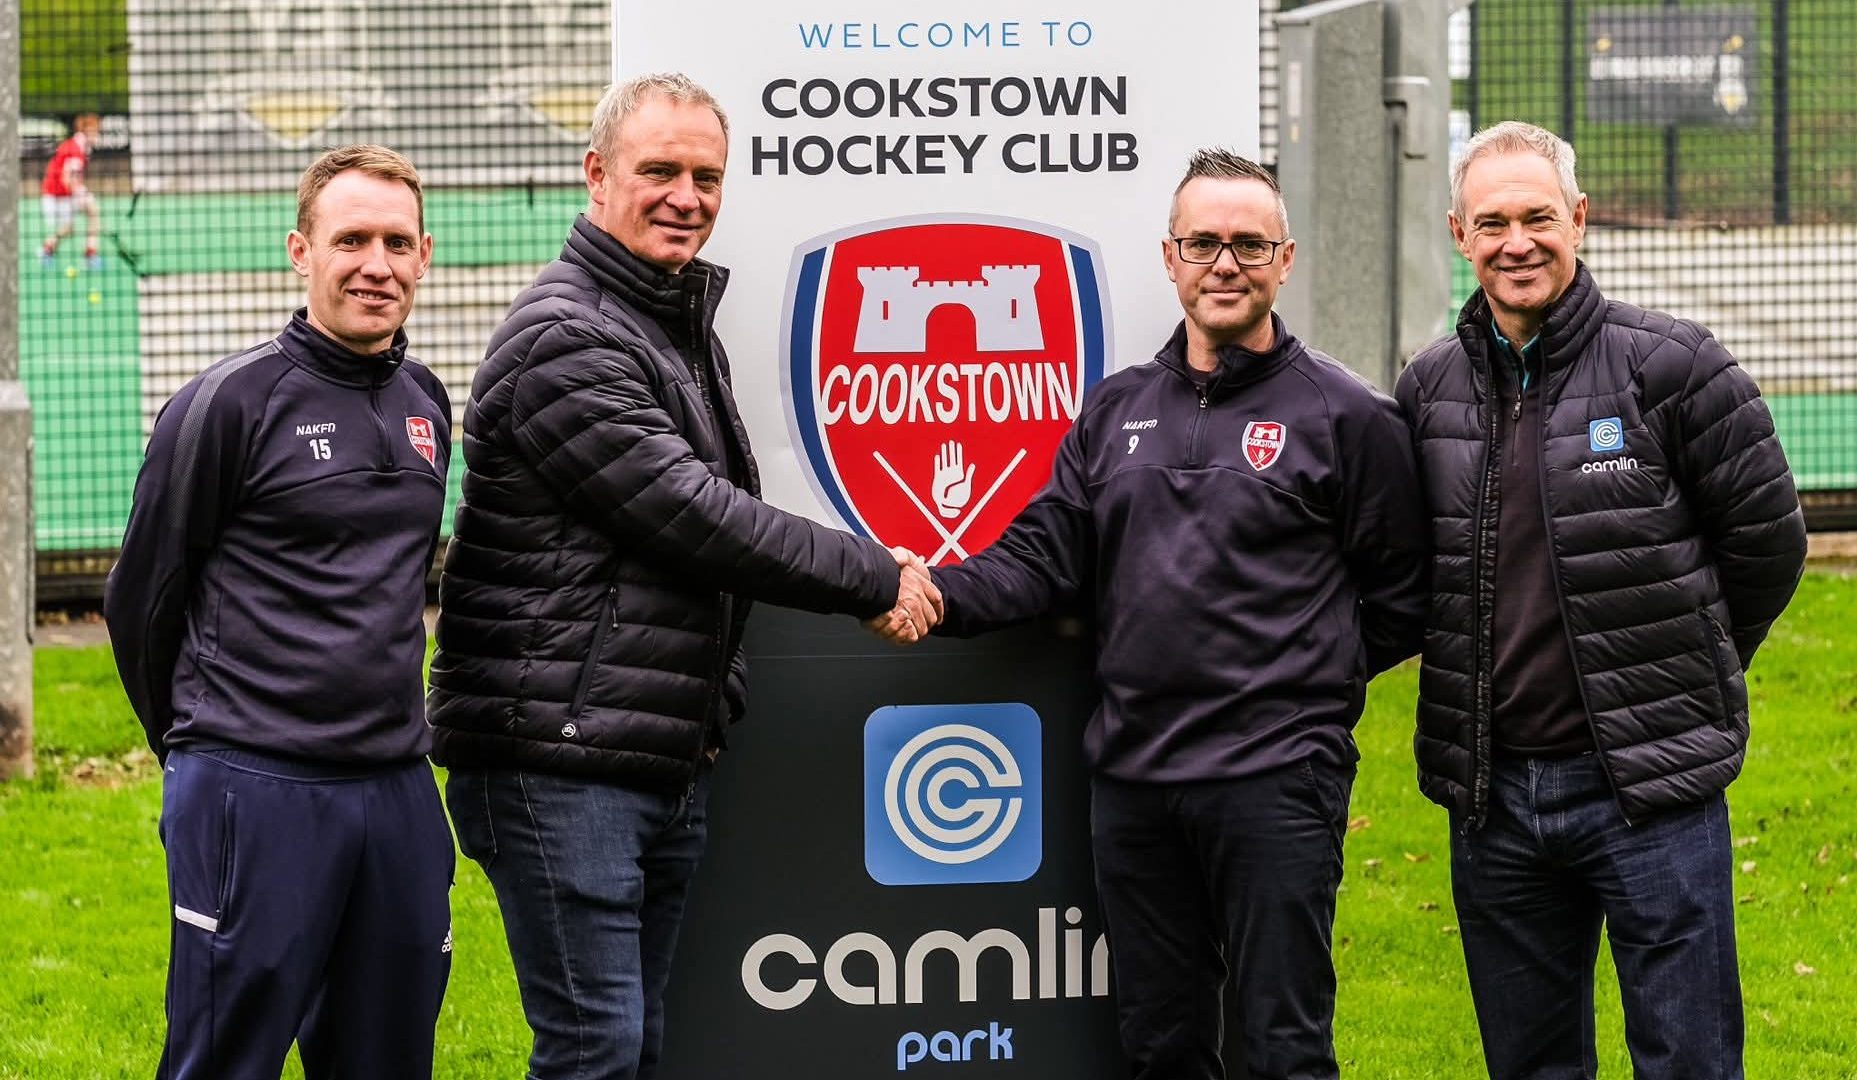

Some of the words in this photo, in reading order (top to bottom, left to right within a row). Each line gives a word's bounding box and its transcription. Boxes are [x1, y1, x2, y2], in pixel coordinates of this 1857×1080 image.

[798, 22, 1020, 49] WELCOME
[1041, 21, 1093, 47] TO
[761, 75, 1127, 119] COOKSTOWN
[751, 134, 988, 176] HOCKEY
[1001, 132, 1140, 174] CLUB
[821, 361, 1076, 425] COOKSTOWN
[309, 438, 332, 460] 15
[1127, 434, 1140, 455] 9
[1581, 456, 1638, 474] camlin
[897, 1021, 1014, 1071] park
